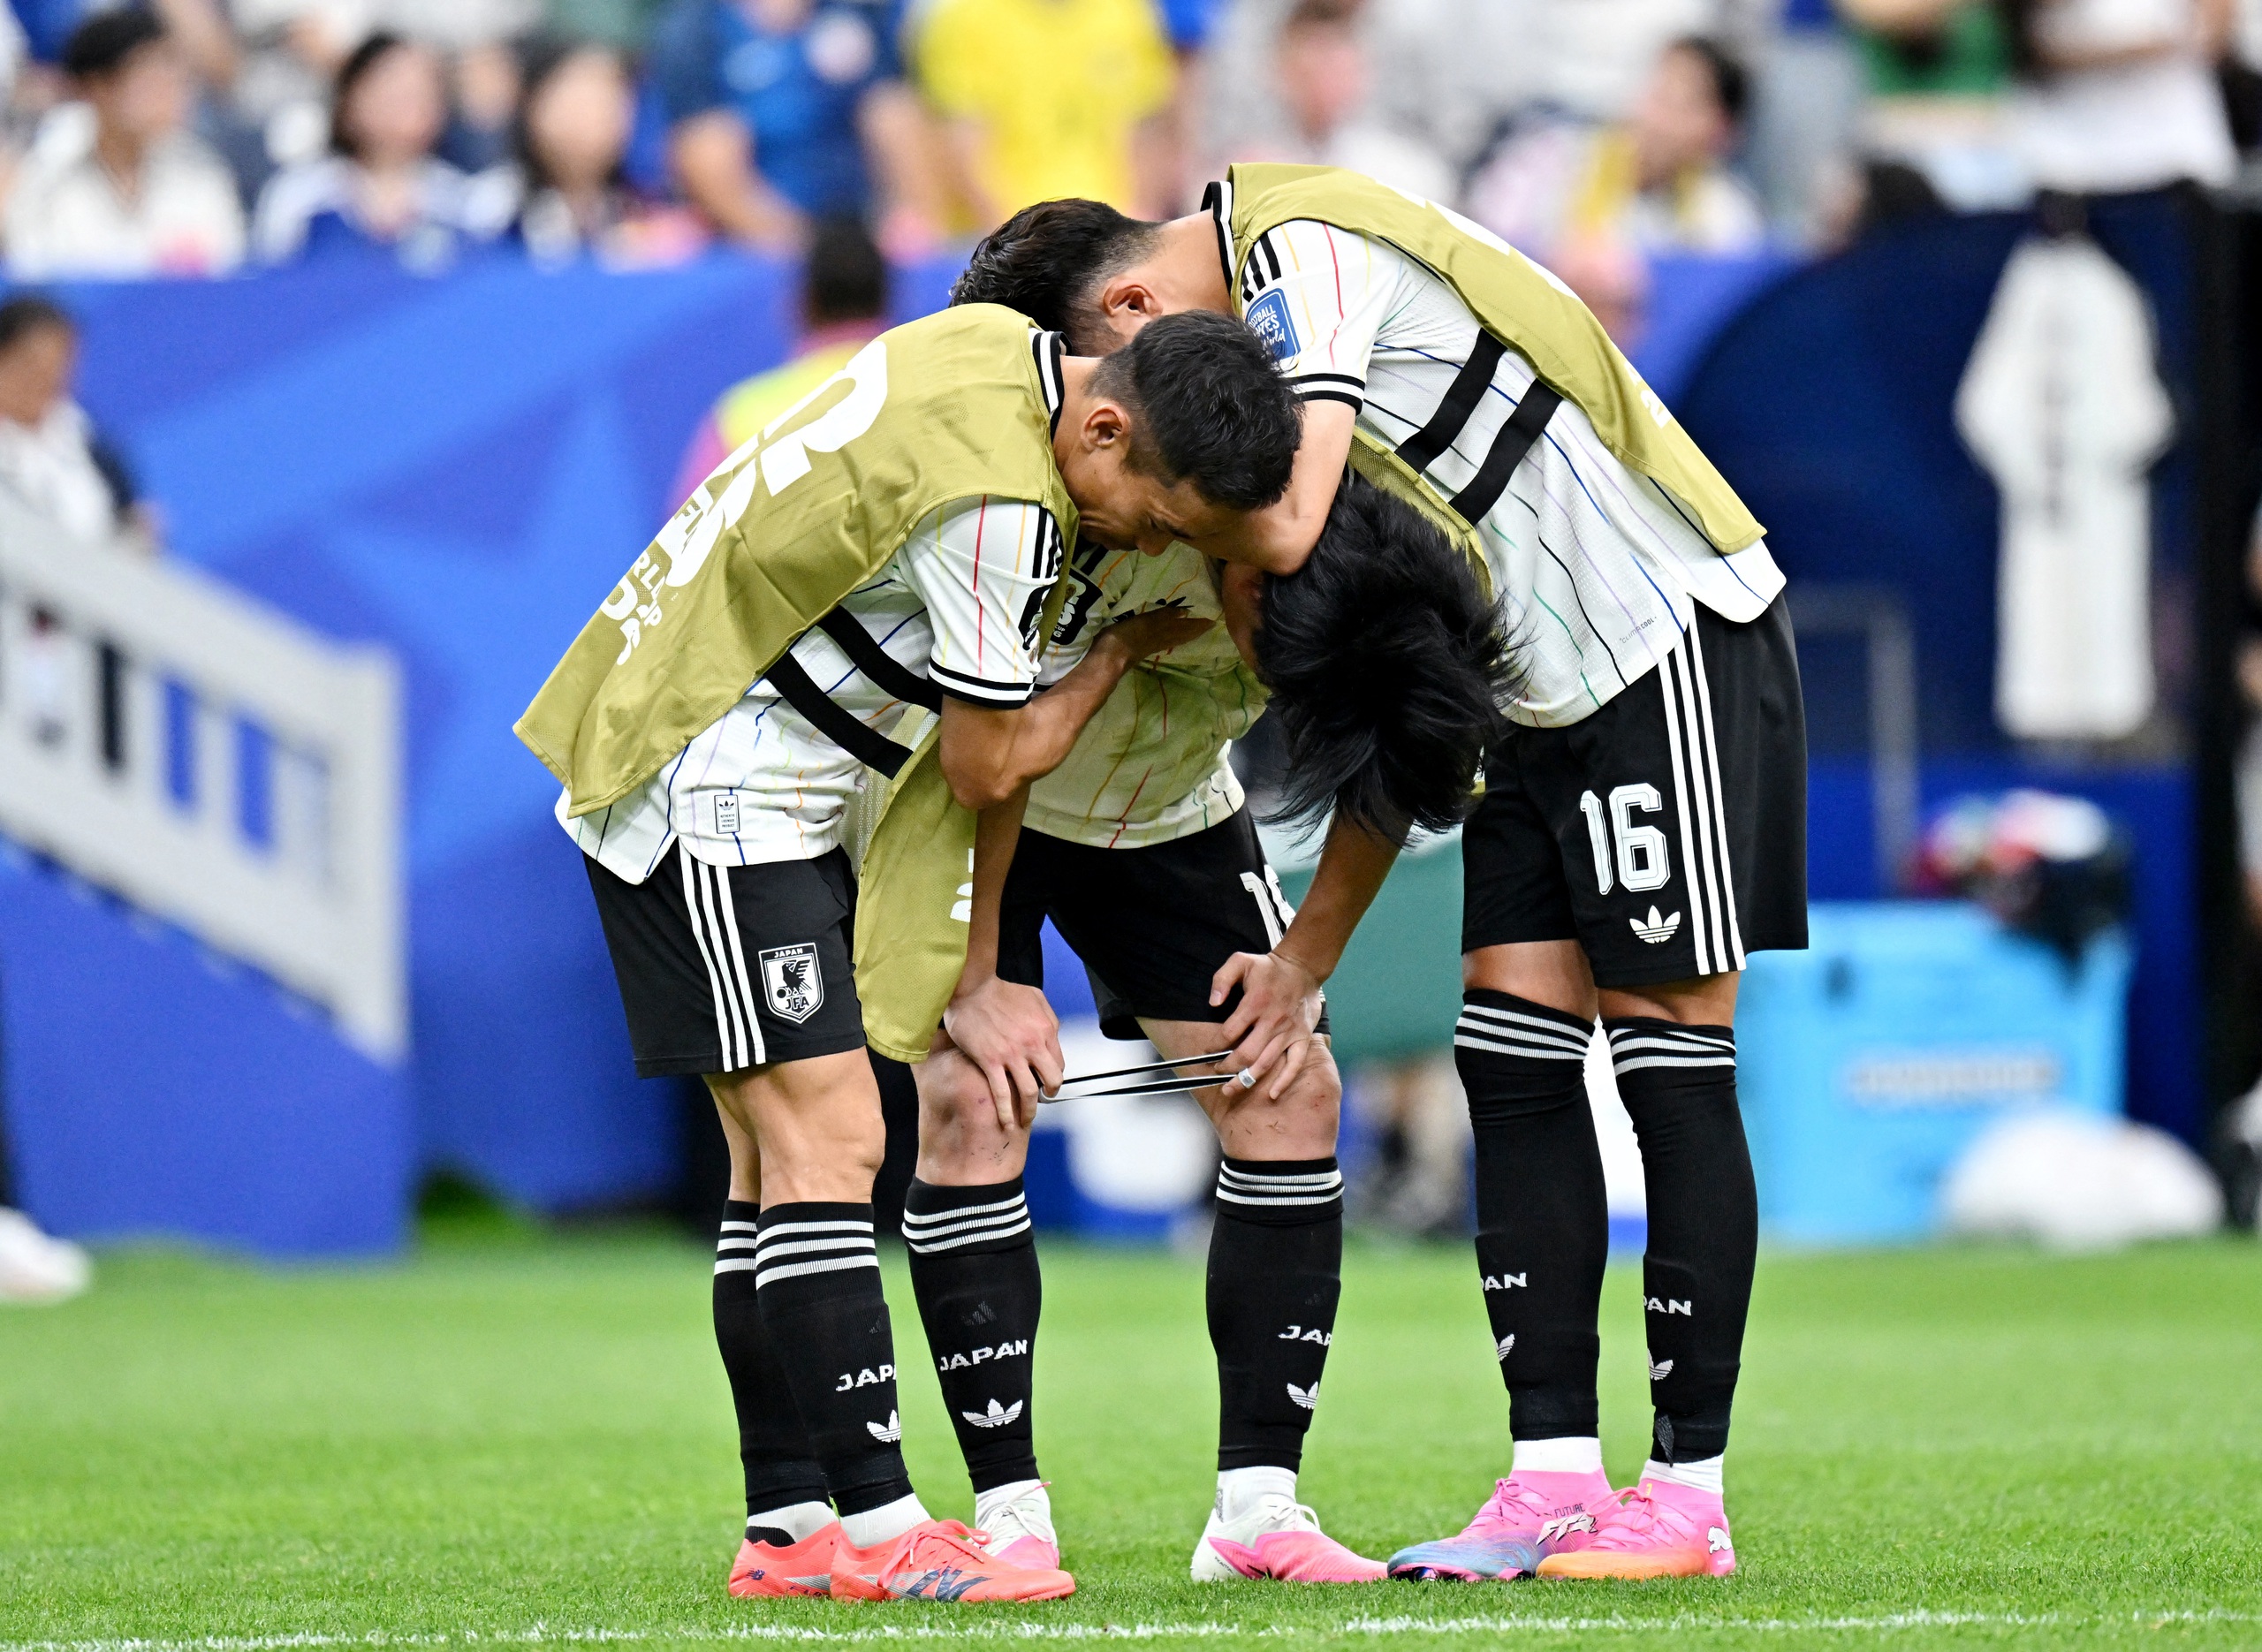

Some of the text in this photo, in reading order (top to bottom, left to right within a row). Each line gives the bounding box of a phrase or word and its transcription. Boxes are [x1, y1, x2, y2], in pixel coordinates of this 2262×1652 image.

[1580, 783, 1670, 895] 16
[774, 948, 803, 959] JAPAN
[786, 997, 809, 1010] JFA
[1481, 1272, 1527, 1291] AN
[1643, 1295, 1692, 1316] AN
[939, 1339, 1028, 1372] JAPAN
[836, 1364, 896, 1391] JAP
[1554, 1503, 1586, 1519] FUTURE
